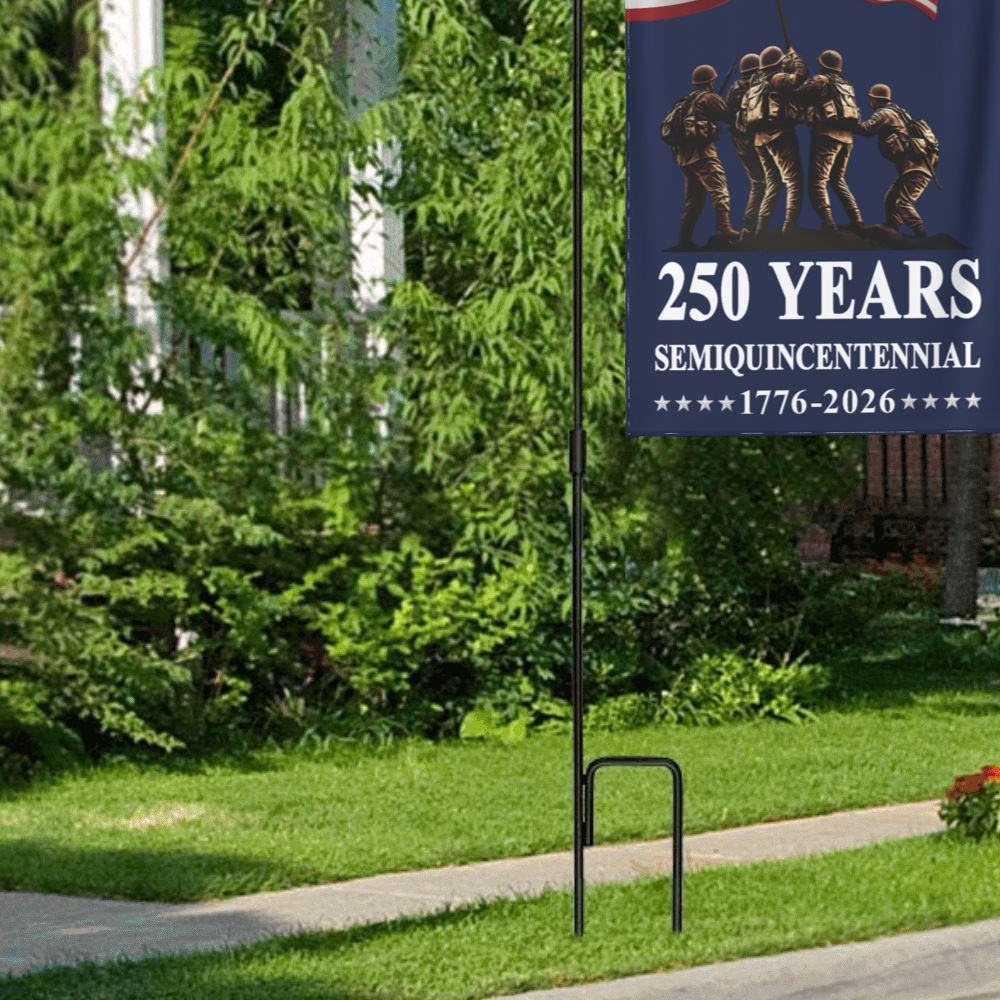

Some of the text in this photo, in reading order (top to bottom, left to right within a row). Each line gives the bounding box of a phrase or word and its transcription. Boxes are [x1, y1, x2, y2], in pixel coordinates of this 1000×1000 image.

[657, 258, 982, 322] 250 YEARS
[654, 341, 981, 377] SEMIQUINCENTENNIAL
[740, 388, 896, 415] 1776-2026
